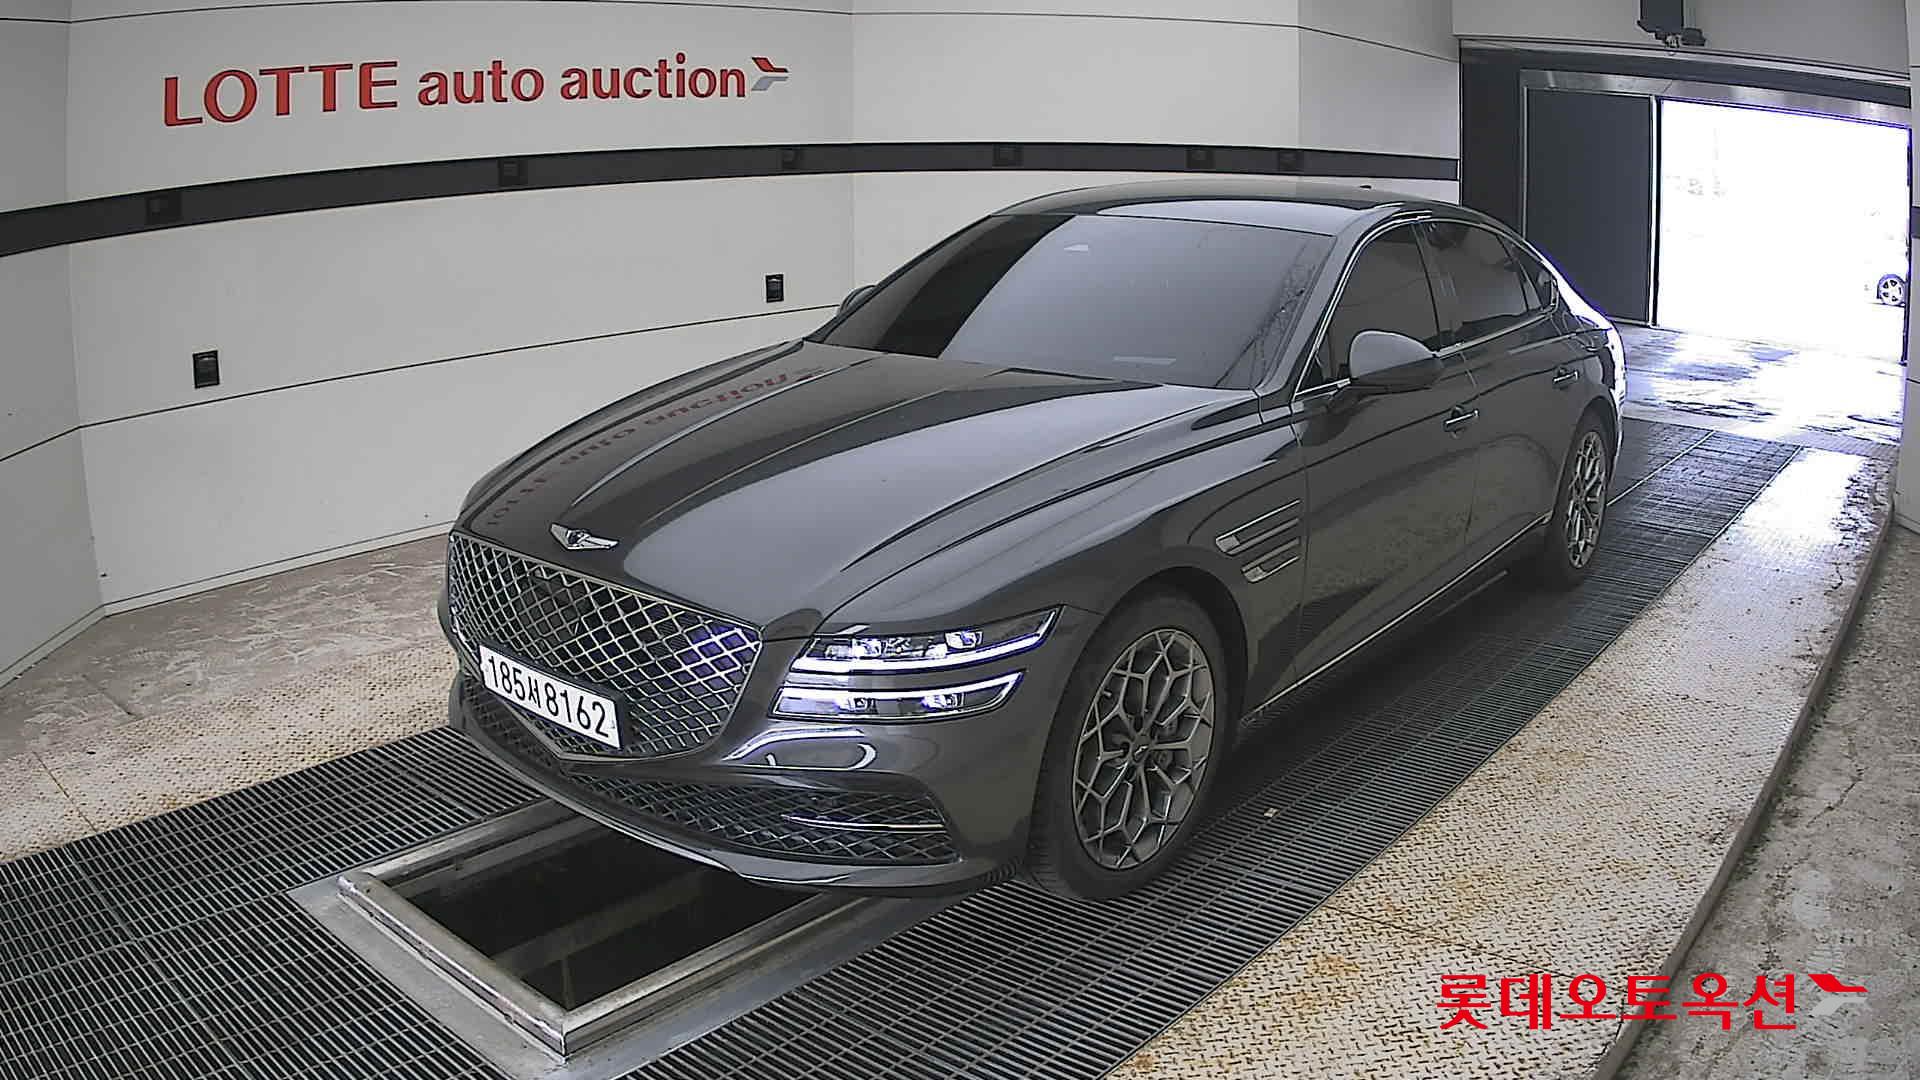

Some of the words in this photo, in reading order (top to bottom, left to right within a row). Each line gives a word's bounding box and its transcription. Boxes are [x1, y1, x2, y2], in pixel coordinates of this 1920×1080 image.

[164, 60, 398, 127] LOTTE
[417, 60, 545, 106] auto
[560, 52, 747, 100] auction
